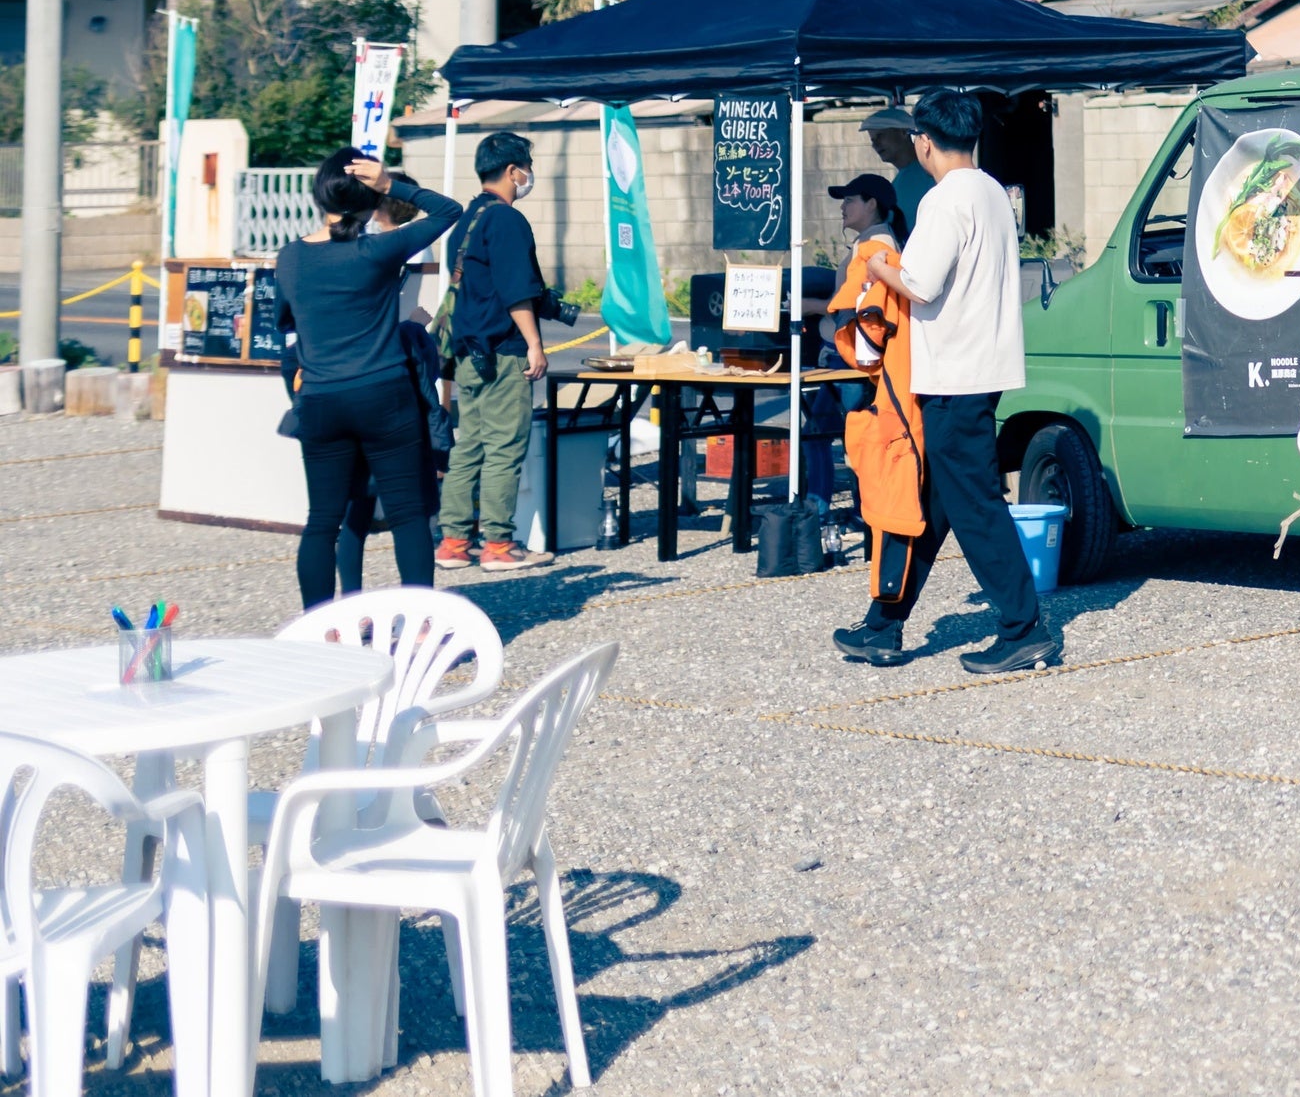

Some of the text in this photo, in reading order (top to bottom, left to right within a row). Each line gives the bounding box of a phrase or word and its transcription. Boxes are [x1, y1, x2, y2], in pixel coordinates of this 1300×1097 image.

[718, 101, 778, 119] MINEOKA
[721, 120, 768, 140] GIBIER
[726, 166, 774, 183] ソーセージ
[743, 183, 771, 200] 700円
[1270, 357, 1299, 366] NOODLE
[1248, 362, 1271, 388] K.
